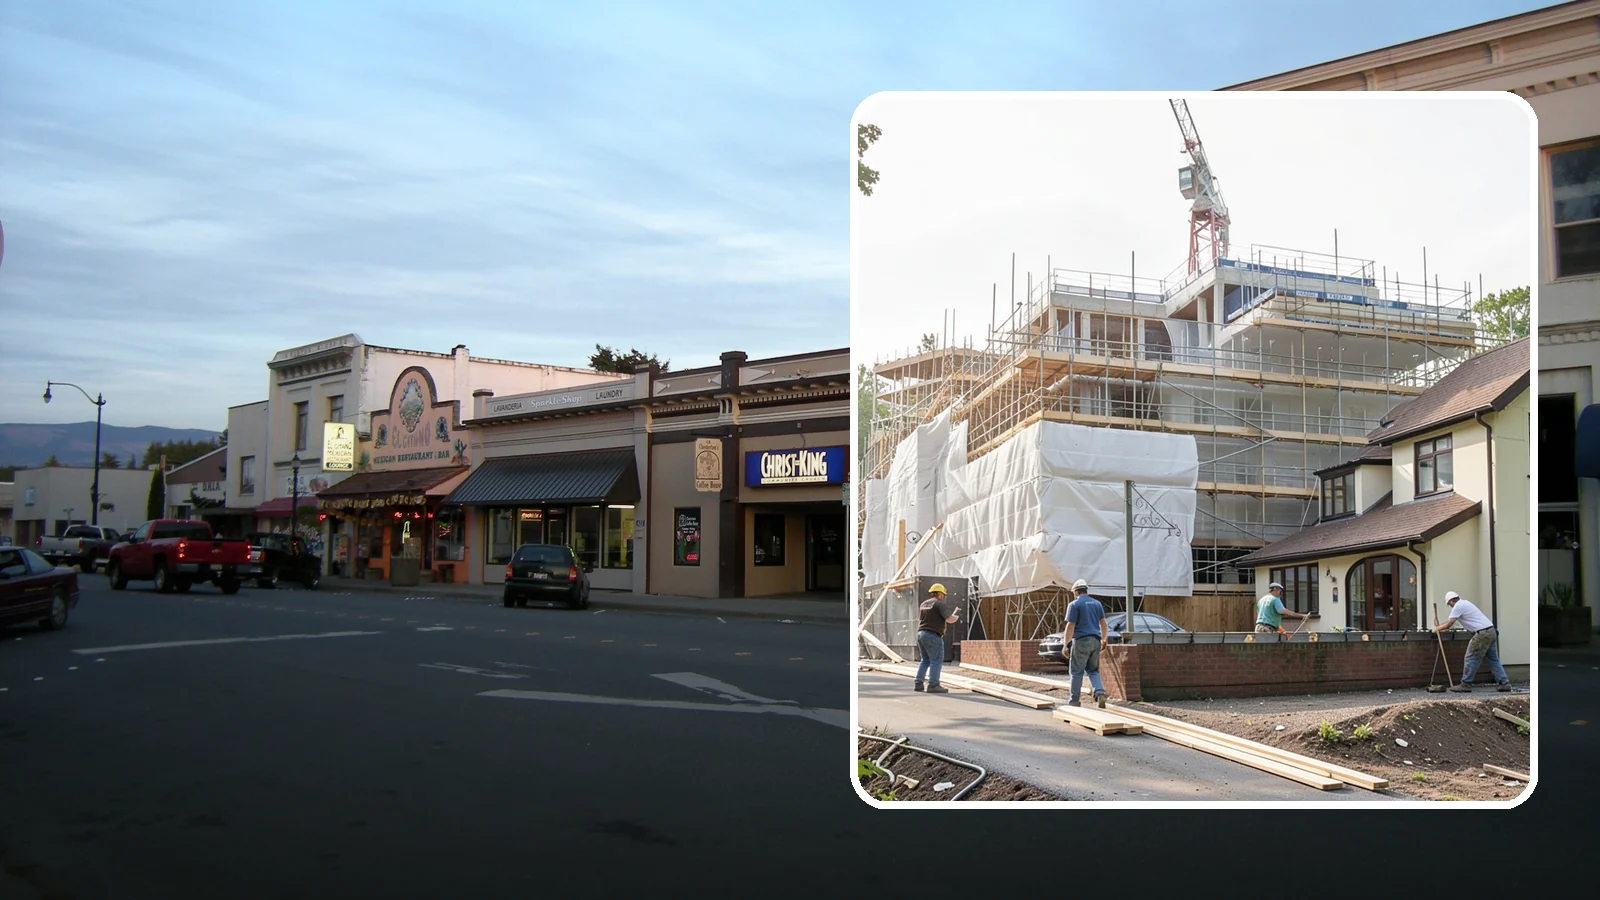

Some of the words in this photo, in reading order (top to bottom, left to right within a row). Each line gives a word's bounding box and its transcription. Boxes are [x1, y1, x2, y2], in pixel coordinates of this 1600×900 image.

[561, 394, 582, 405] Shop
[595, 389, 623, 400] LAUNDRY
[493, 402, 523, 412] LAVANDERIA
[374, 455, 396, 464] MEXICAN
[397, 451, 433, 462] RESTAURANT
[437, 450, 450, 459] BAR
